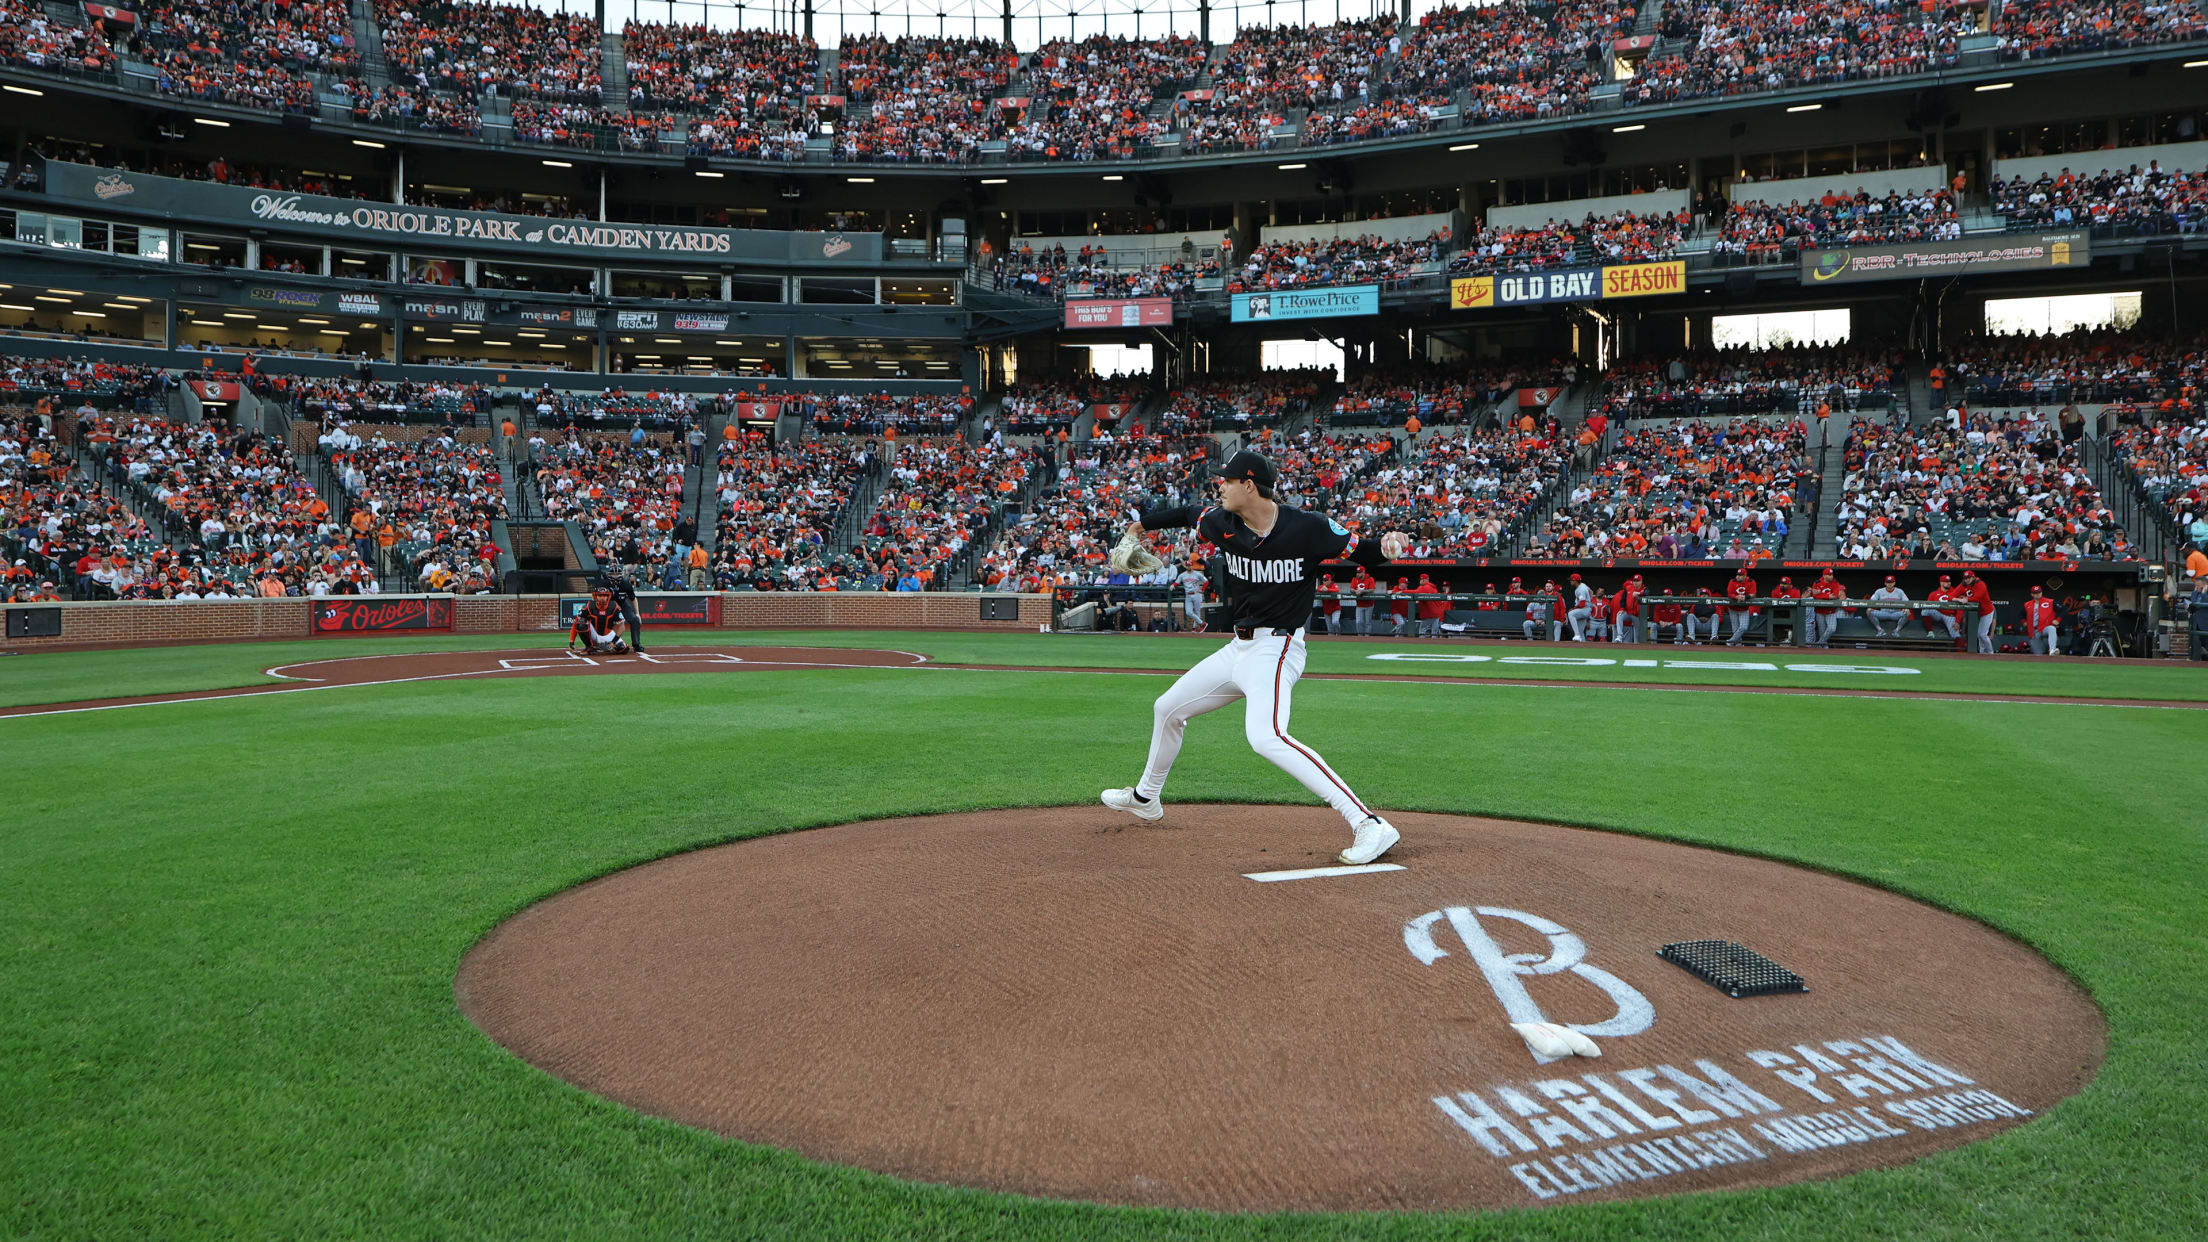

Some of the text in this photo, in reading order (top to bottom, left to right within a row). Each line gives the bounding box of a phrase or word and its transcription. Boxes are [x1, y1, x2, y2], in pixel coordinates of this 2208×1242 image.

[250, 194, 333, 225] Welcome
[333, 211, 351, 226] to
[352, 207, 451, 236] ORIOLE
[455, 217, 521, 241] PARK
[548, 224, 651, 249] CAMDEN
[655, 231, 731, 253] YARDS
[1608, 265, 1679, 294] SEASON
[1501, 276, 1544, 302] OLD
[340, 294, 378, 304] WBAL
[463, 301, 486, 311] EVERY
[576, 308, 597, 319] EVERY
[618, 311, 658, 321] ESPN
[1074, 305, 1113, 314] THIS BUD'S
[1078, 313, 1108, 322] FOR YOU
[674, 320, 699, 329] 93.9
[1225, 551, 1304, 583] BALTIMORE
[352, 600, 426, 630] Orioles
[1432, 1034, 1976, 1158] HARLEM PARK
[1508, 1088, 2035, 1199] ELEMENTARY MIDDLE SCHOOL
